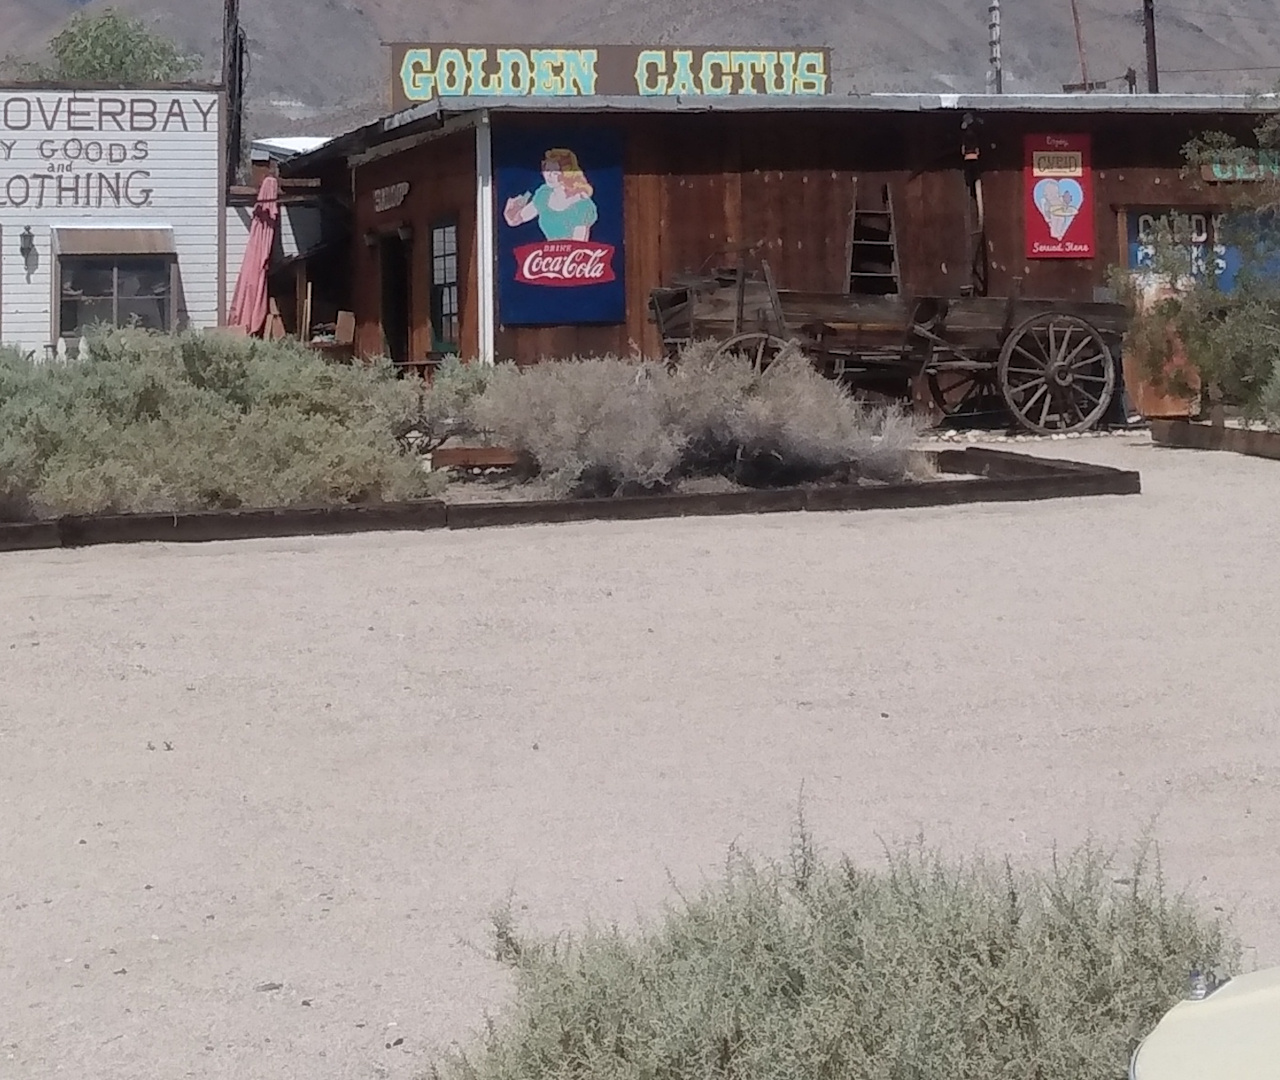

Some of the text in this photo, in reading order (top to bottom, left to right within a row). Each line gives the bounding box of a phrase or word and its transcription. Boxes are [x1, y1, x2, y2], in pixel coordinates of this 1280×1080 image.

[400, 48, 828, 101] GOLDEN CACTUS
[3, 97, 218, 132] OVERBAY
[38, 137, 150, 165] GOODS
[47, 160, 74, 174] and
[543, 245, 572, 253] DRINK
